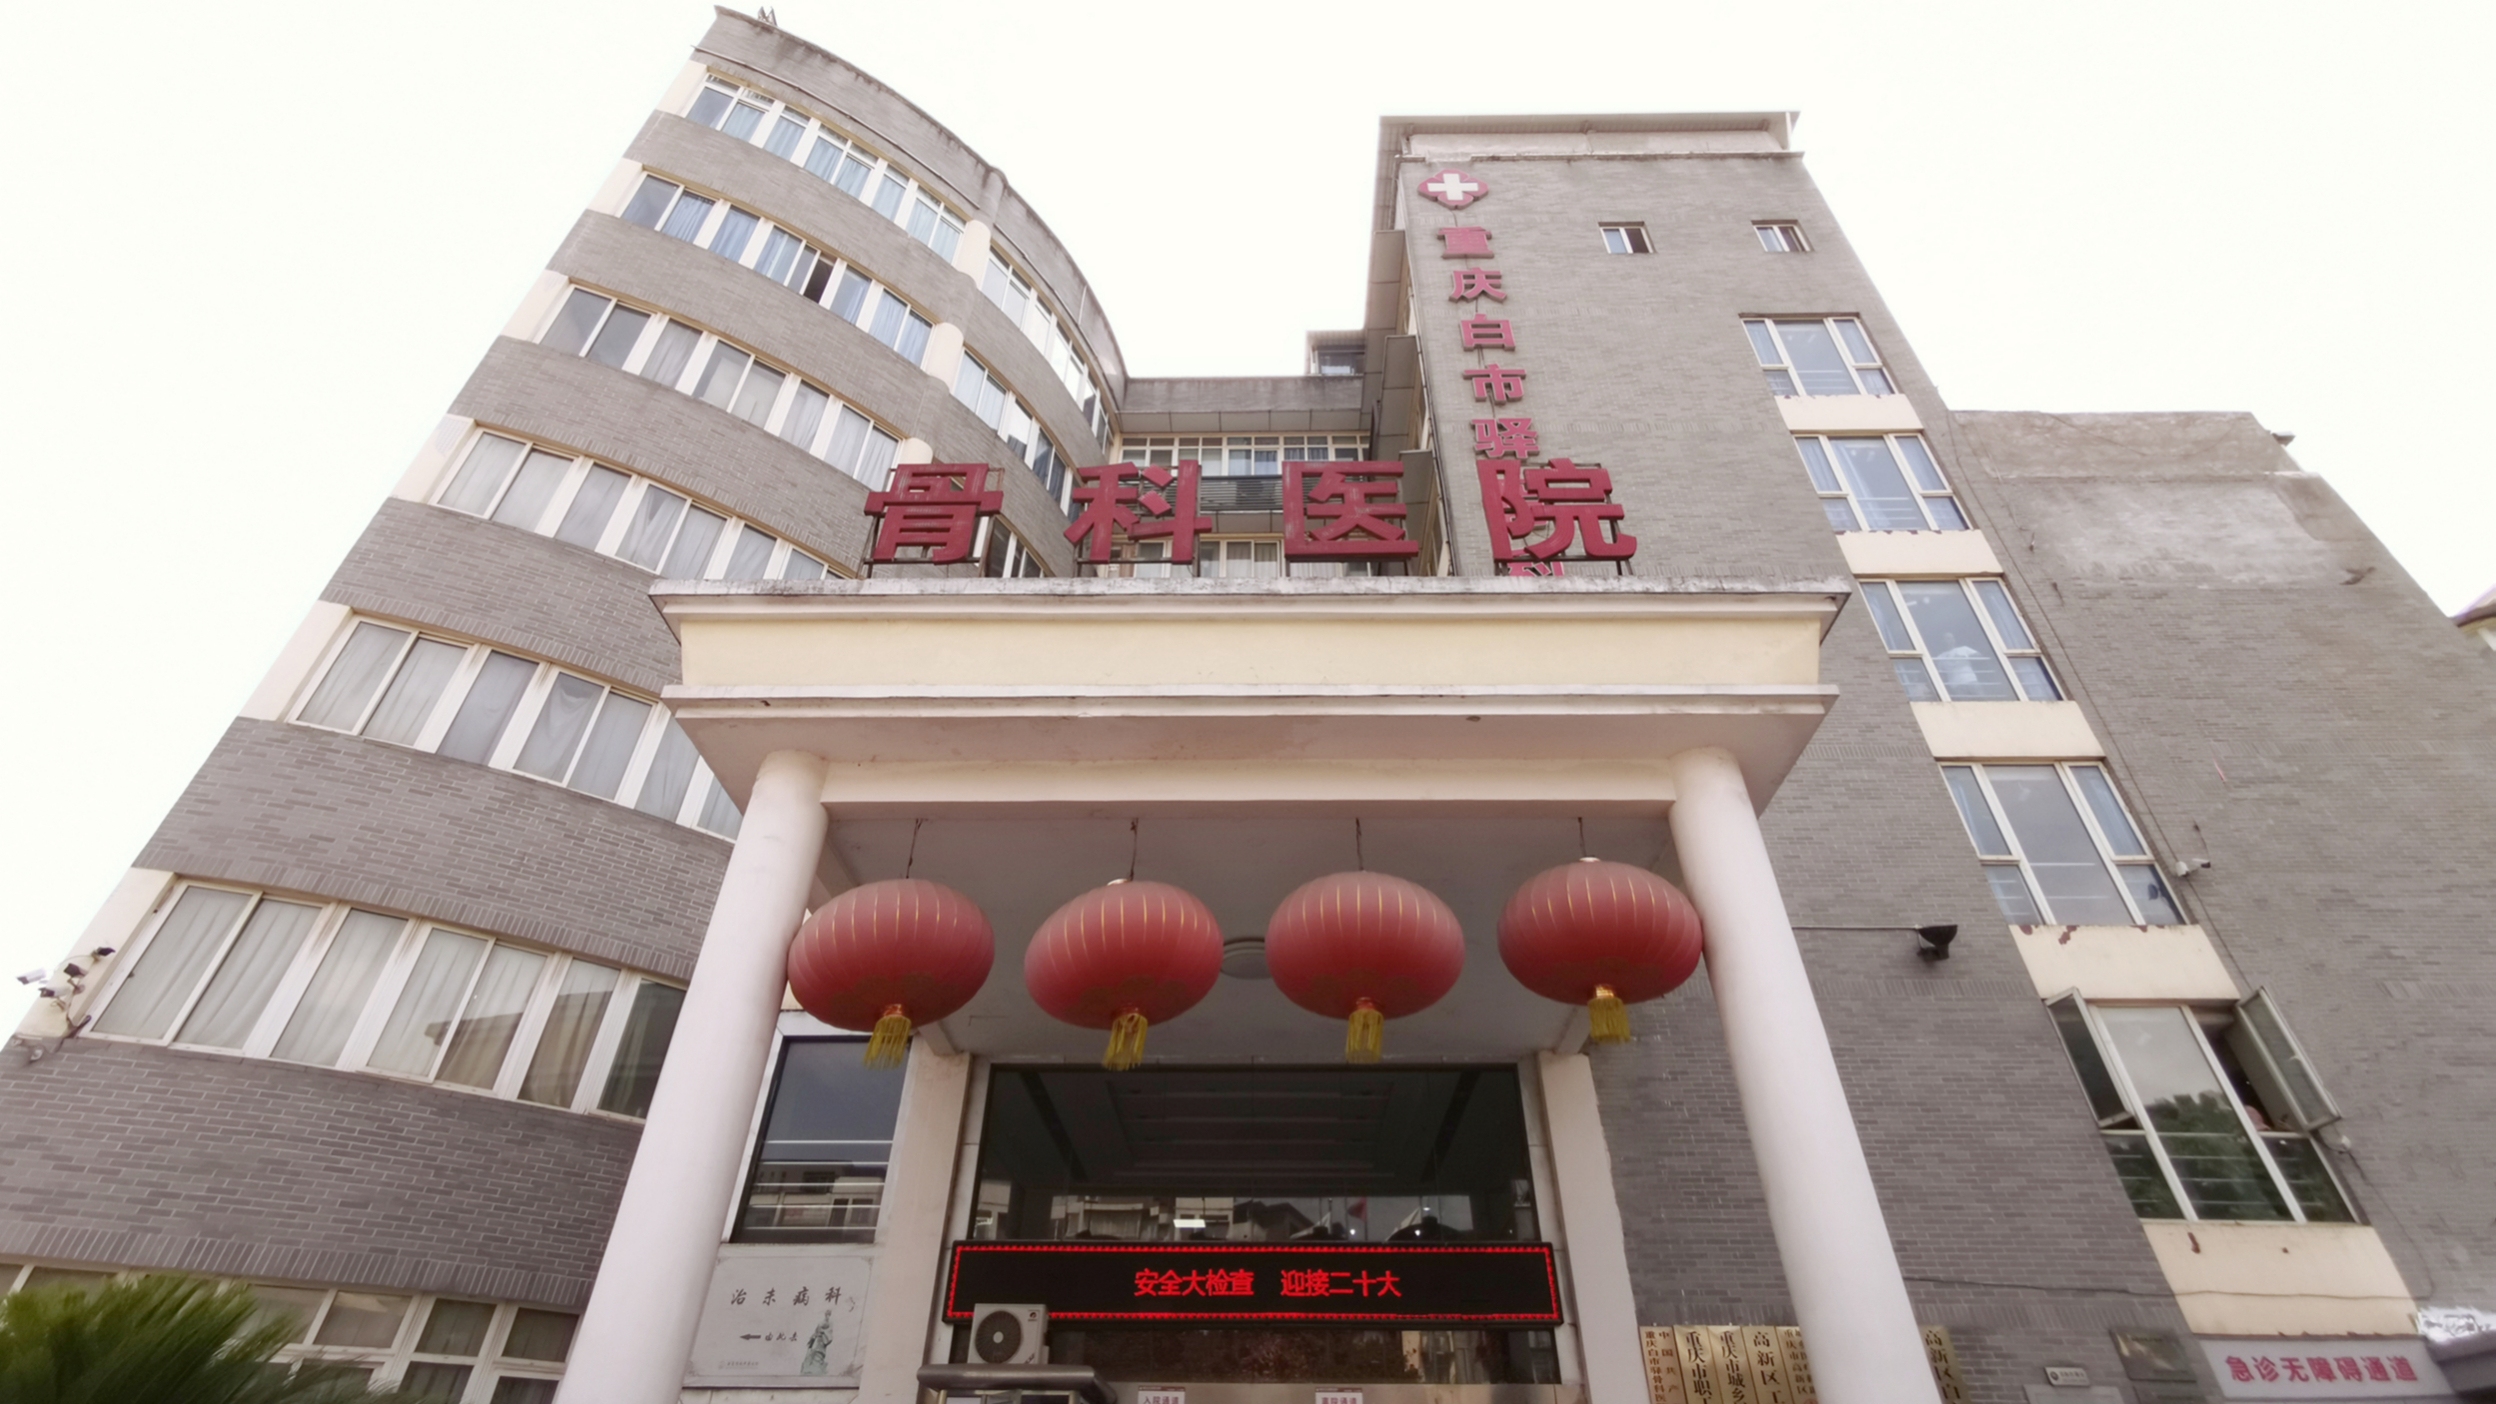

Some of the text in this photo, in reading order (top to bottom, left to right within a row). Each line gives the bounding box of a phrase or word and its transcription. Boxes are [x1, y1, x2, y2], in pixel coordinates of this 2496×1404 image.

[863, 457, 1638, 564] 骨科医院
[730, 1286, 842, 1306] 治未病科
[1134, 1268, 1254, 1297] 安全大检查
[1280, 1269, 1402, 1297] 迎接二十大
[1645, 1331, 1668, 1404] 重庆白市驿骨科医
[1720, 1331, 1746, 1404] 重庆市城乡
[1925, 1329, 1961, 1404] 高新区白
[2225, 1356, 2418, 1382] 急诊无障碍通道
